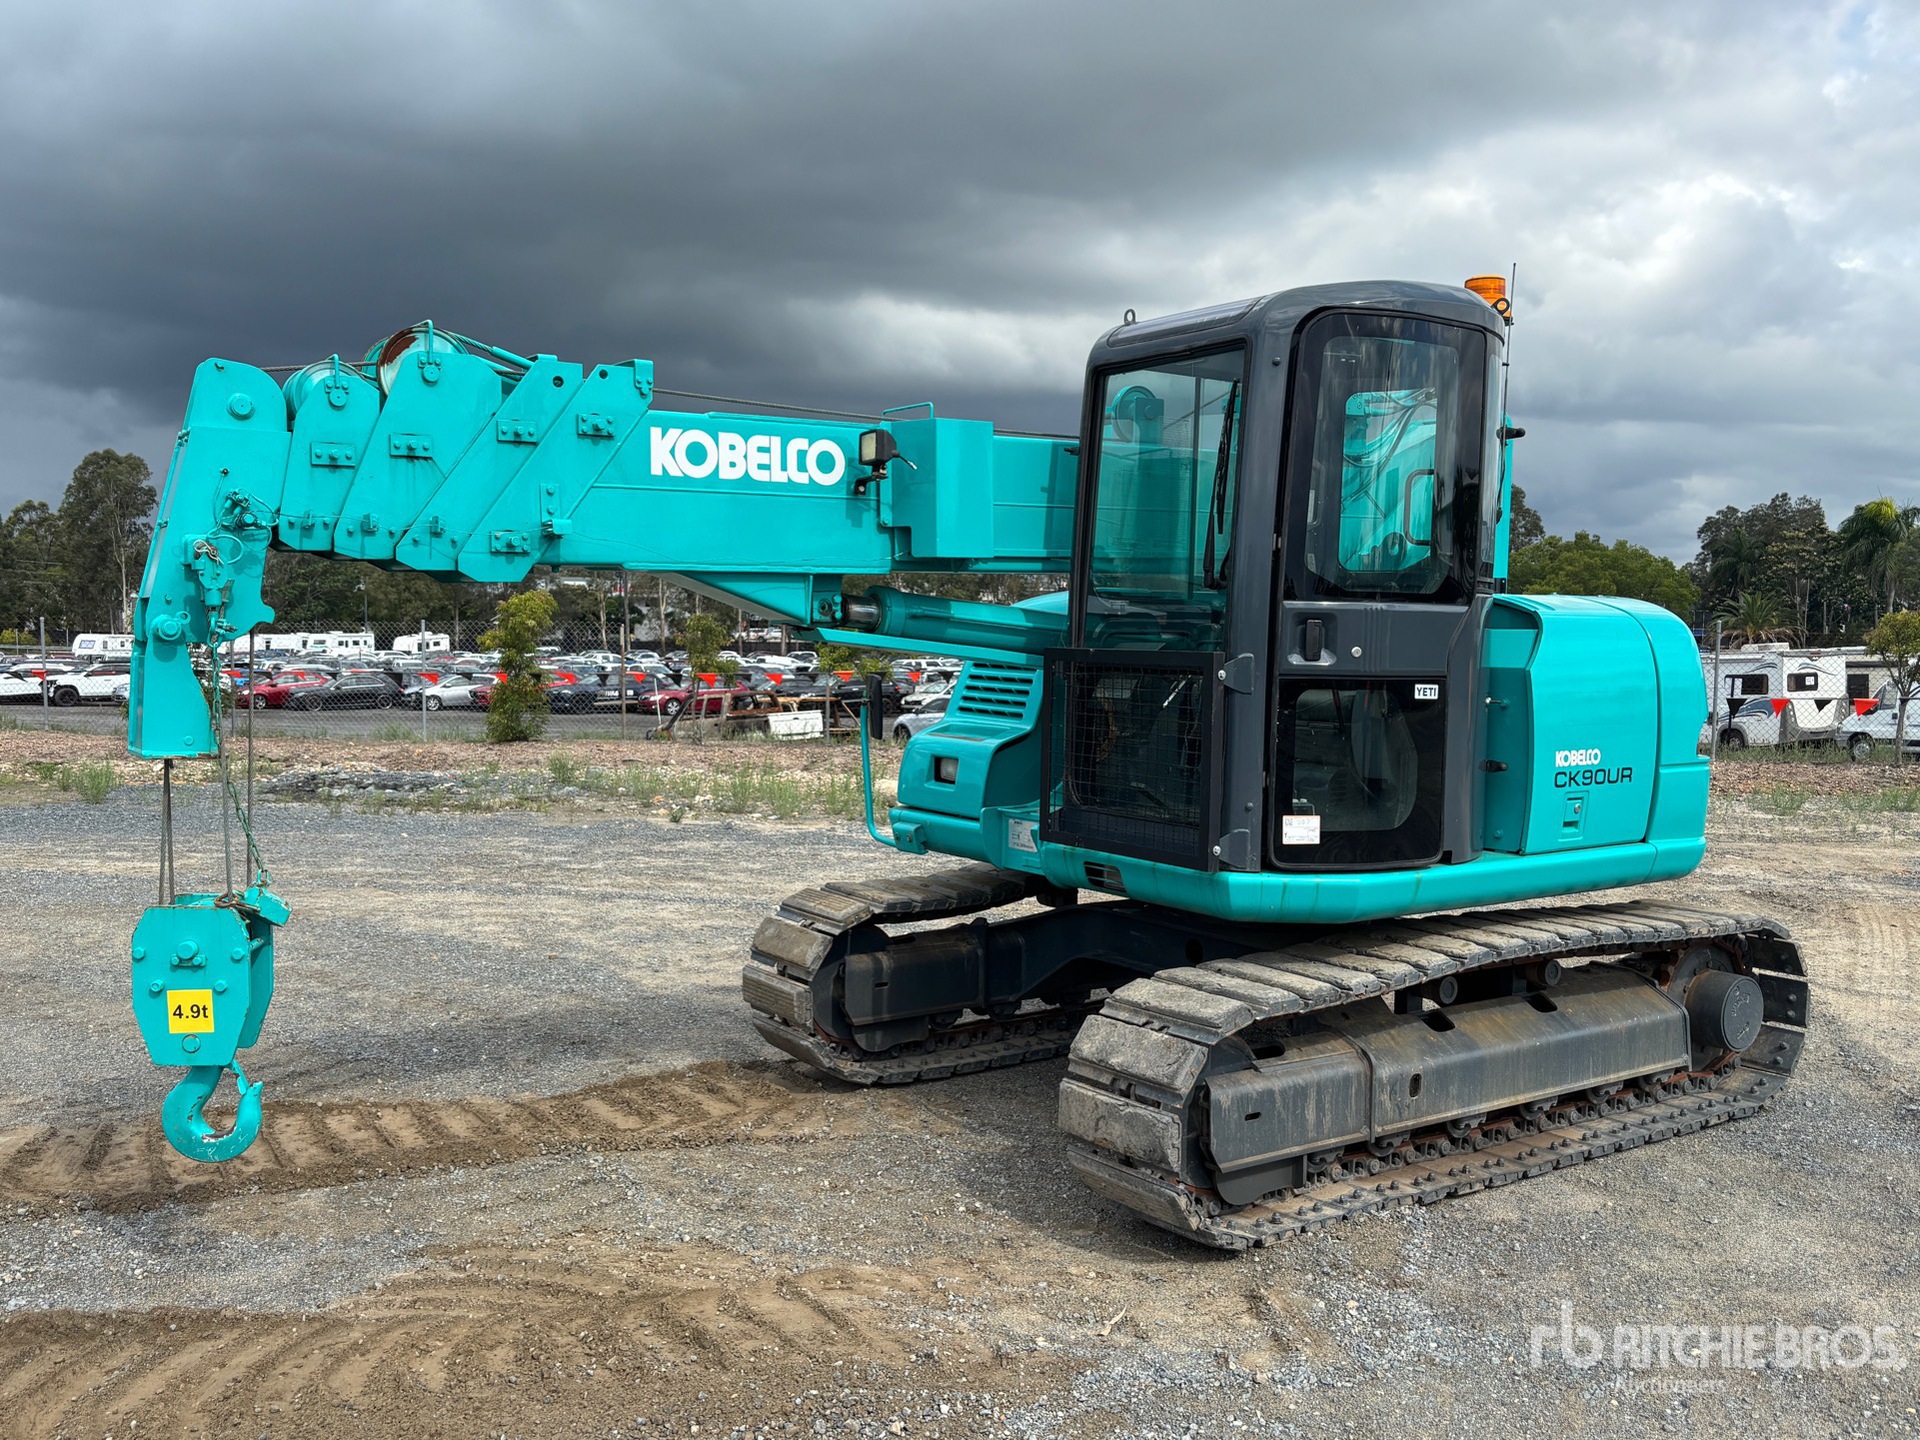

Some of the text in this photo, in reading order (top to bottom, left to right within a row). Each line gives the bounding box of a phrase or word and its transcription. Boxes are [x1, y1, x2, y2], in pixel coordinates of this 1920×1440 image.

[650, 427, 845, 486] KOBELCO
[1416, 686, 1437, 697] YETI
[1555, 748, 1601, 767] KOBELCO
[1554, 767, 1633, 788] CK90UR
[172, 1003, 209, 1019] 4.9t
